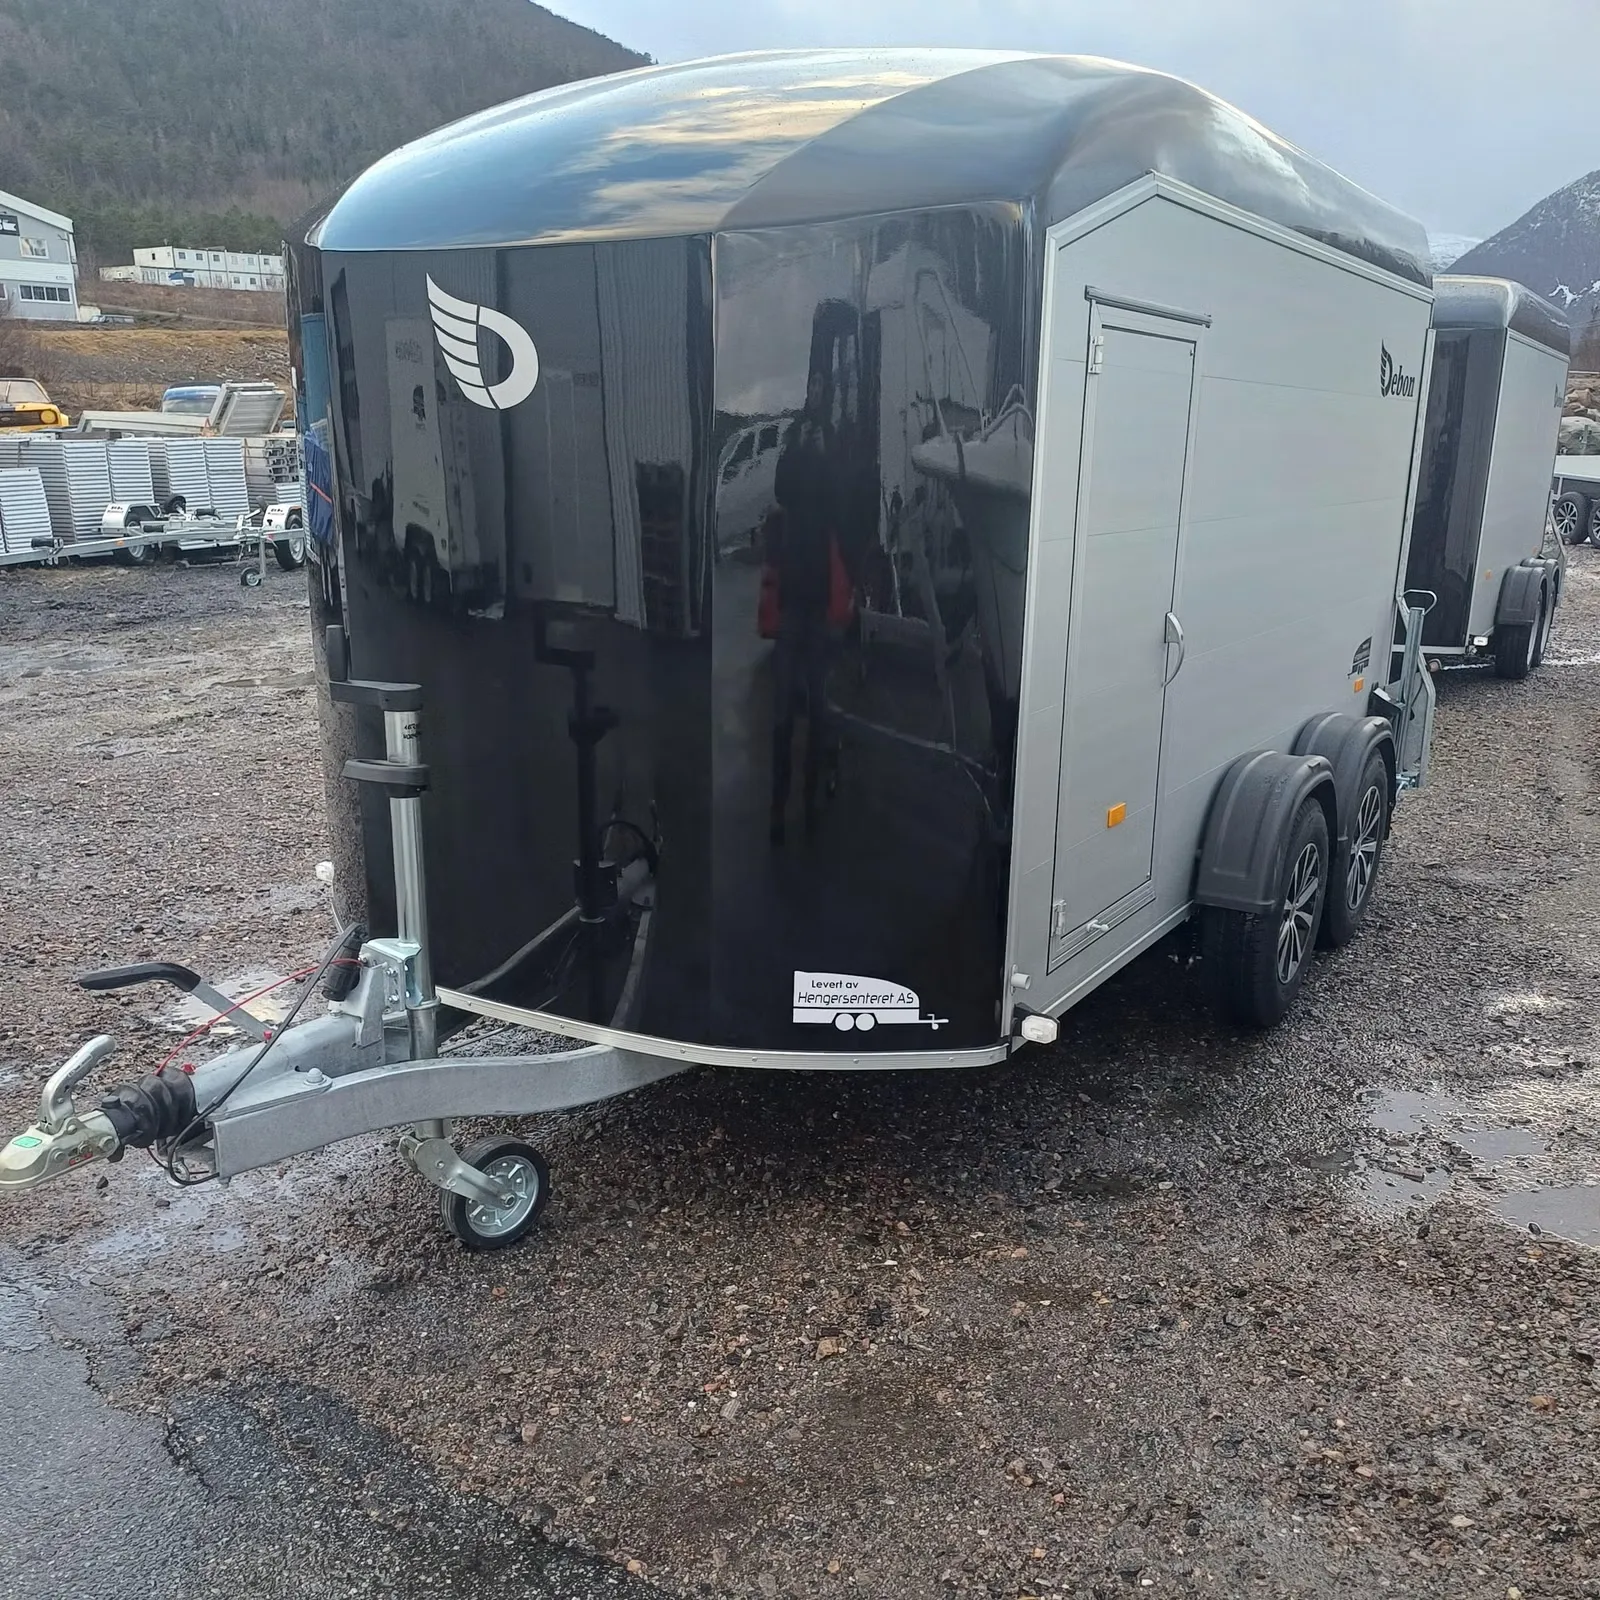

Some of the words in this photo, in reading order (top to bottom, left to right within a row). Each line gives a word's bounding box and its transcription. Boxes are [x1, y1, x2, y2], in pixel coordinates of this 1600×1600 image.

[1381, 339, 1415, 397] Debon
[811, 979, 842, 989] Levert
[845, 981, 859, 989] av
[798, 991, 894, 1006] Hengersenteret
[897, 992, 914, 1004] AS
